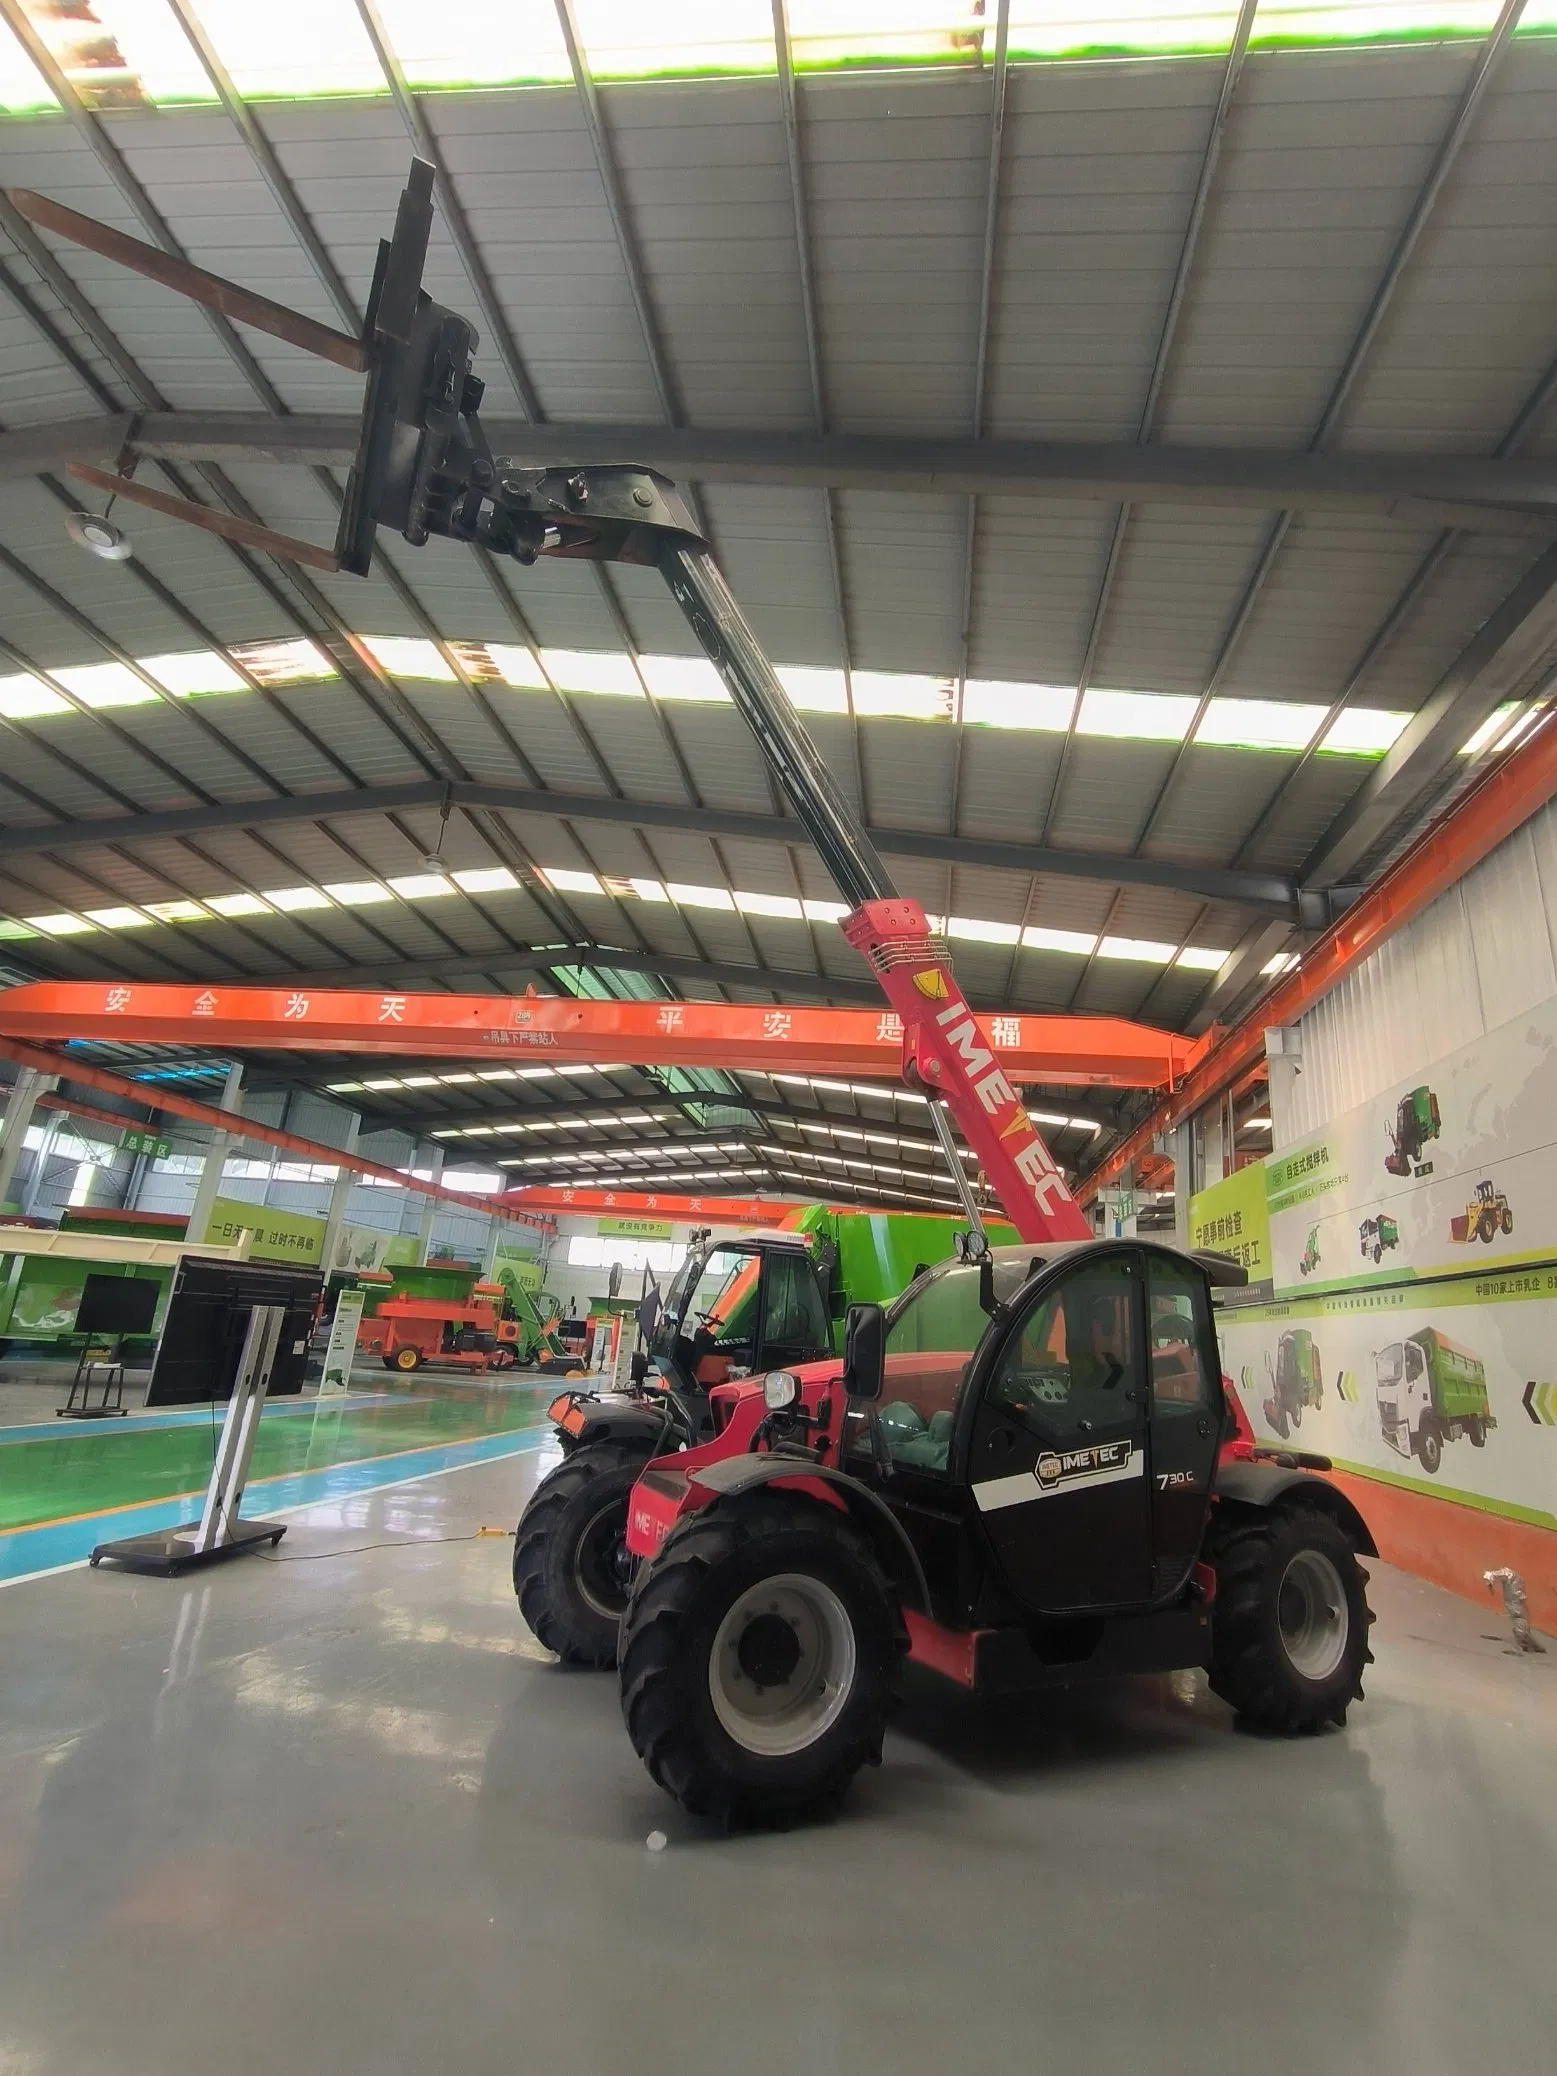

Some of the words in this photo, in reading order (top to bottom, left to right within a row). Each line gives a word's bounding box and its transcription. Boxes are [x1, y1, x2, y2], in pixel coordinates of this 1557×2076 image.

[490, 1030, 558, 1046] 吊具下严禁站人
[935, 1001, 1072, 1207] IMETEC
[126, 1135, 168, 1158] 总装区
[1286, 1147, 1329, 1180] 自走式搅拌机
[562, 1190, 702, 1212] 安全为天
[1195, 1210, 1243, 1249] 宁愿事前检查
[1475, 1277, 1541, 1296] 中国10家上市乳企
[1062, 1446, 1120, 1470] IMETEC
